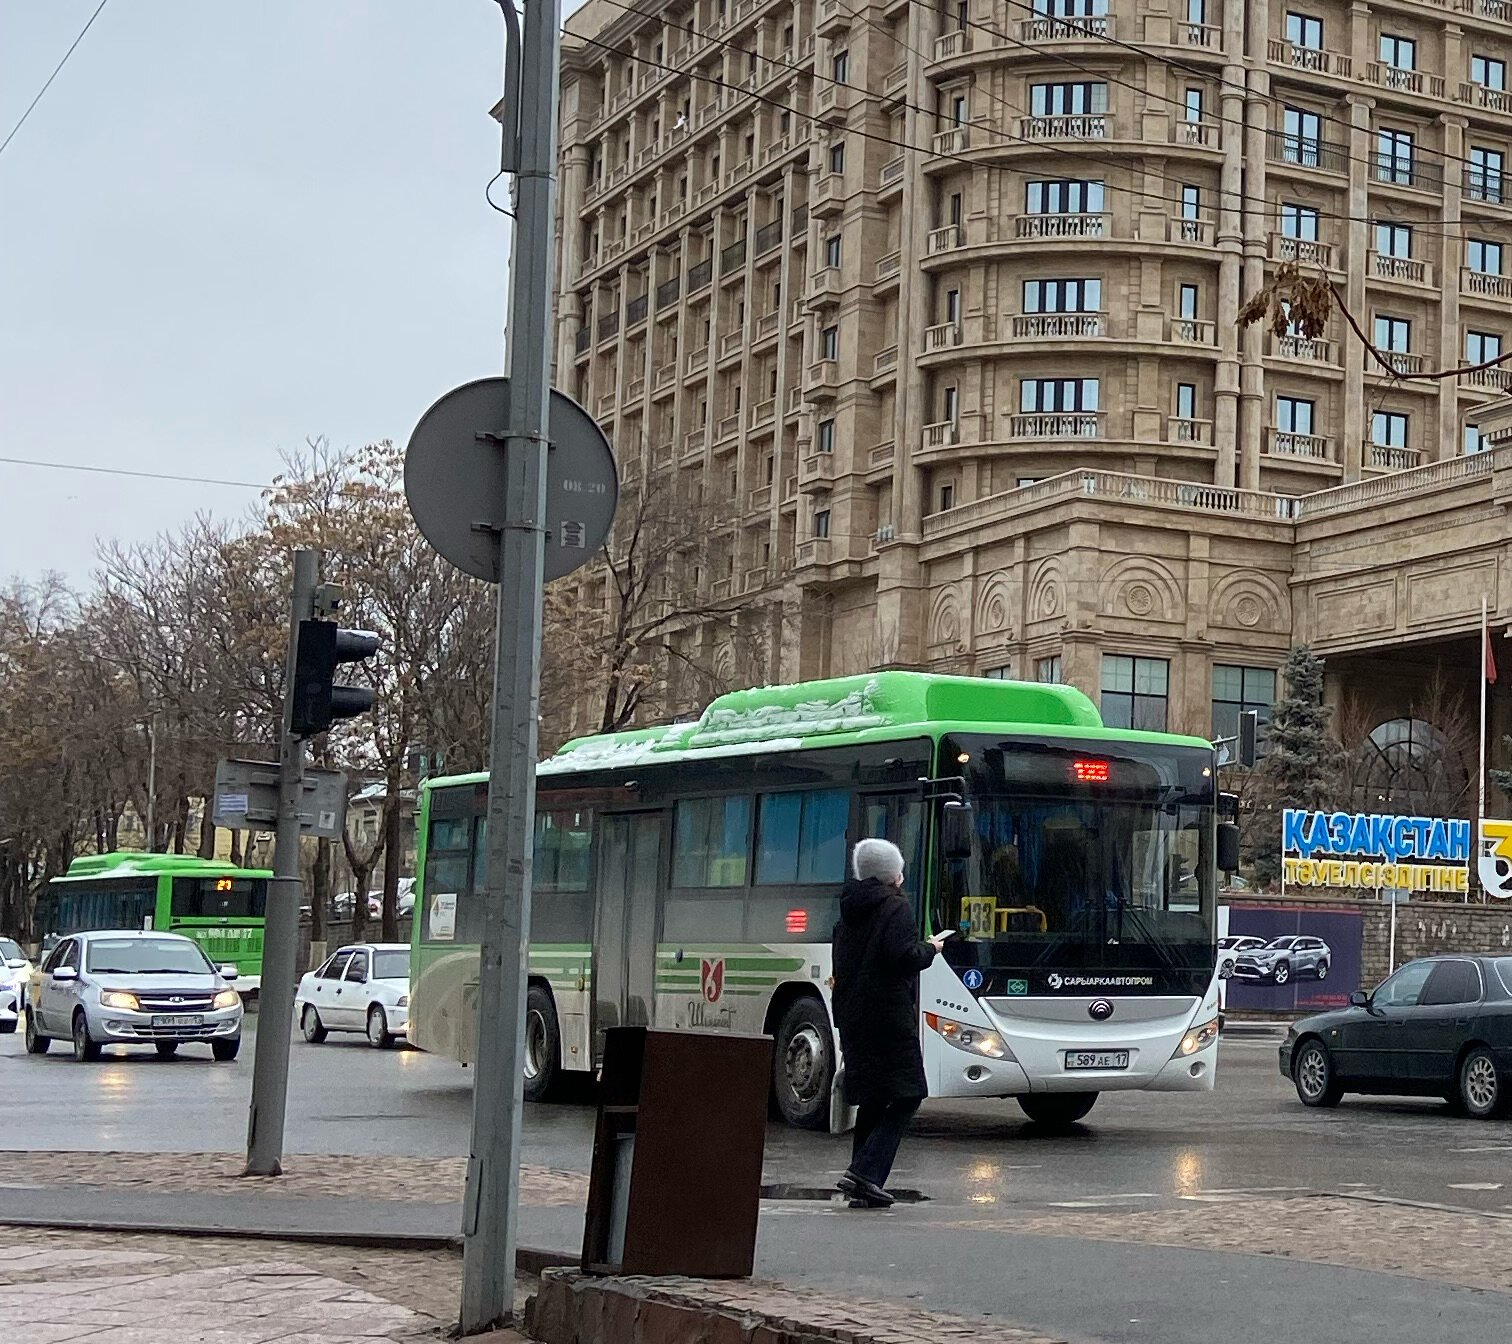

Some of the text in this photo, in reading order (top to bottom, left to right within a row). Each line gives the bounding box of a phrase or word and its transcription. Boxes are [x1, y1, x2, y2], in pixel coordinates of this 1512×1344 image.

[1283, 809, 1471, 864] ҚАЗАҚСТАН
[1283, 858, 1470, 893] ТӘУЕЛСІЗДІГІНЕ
[1077, 1054, 1095, 1066] 589
